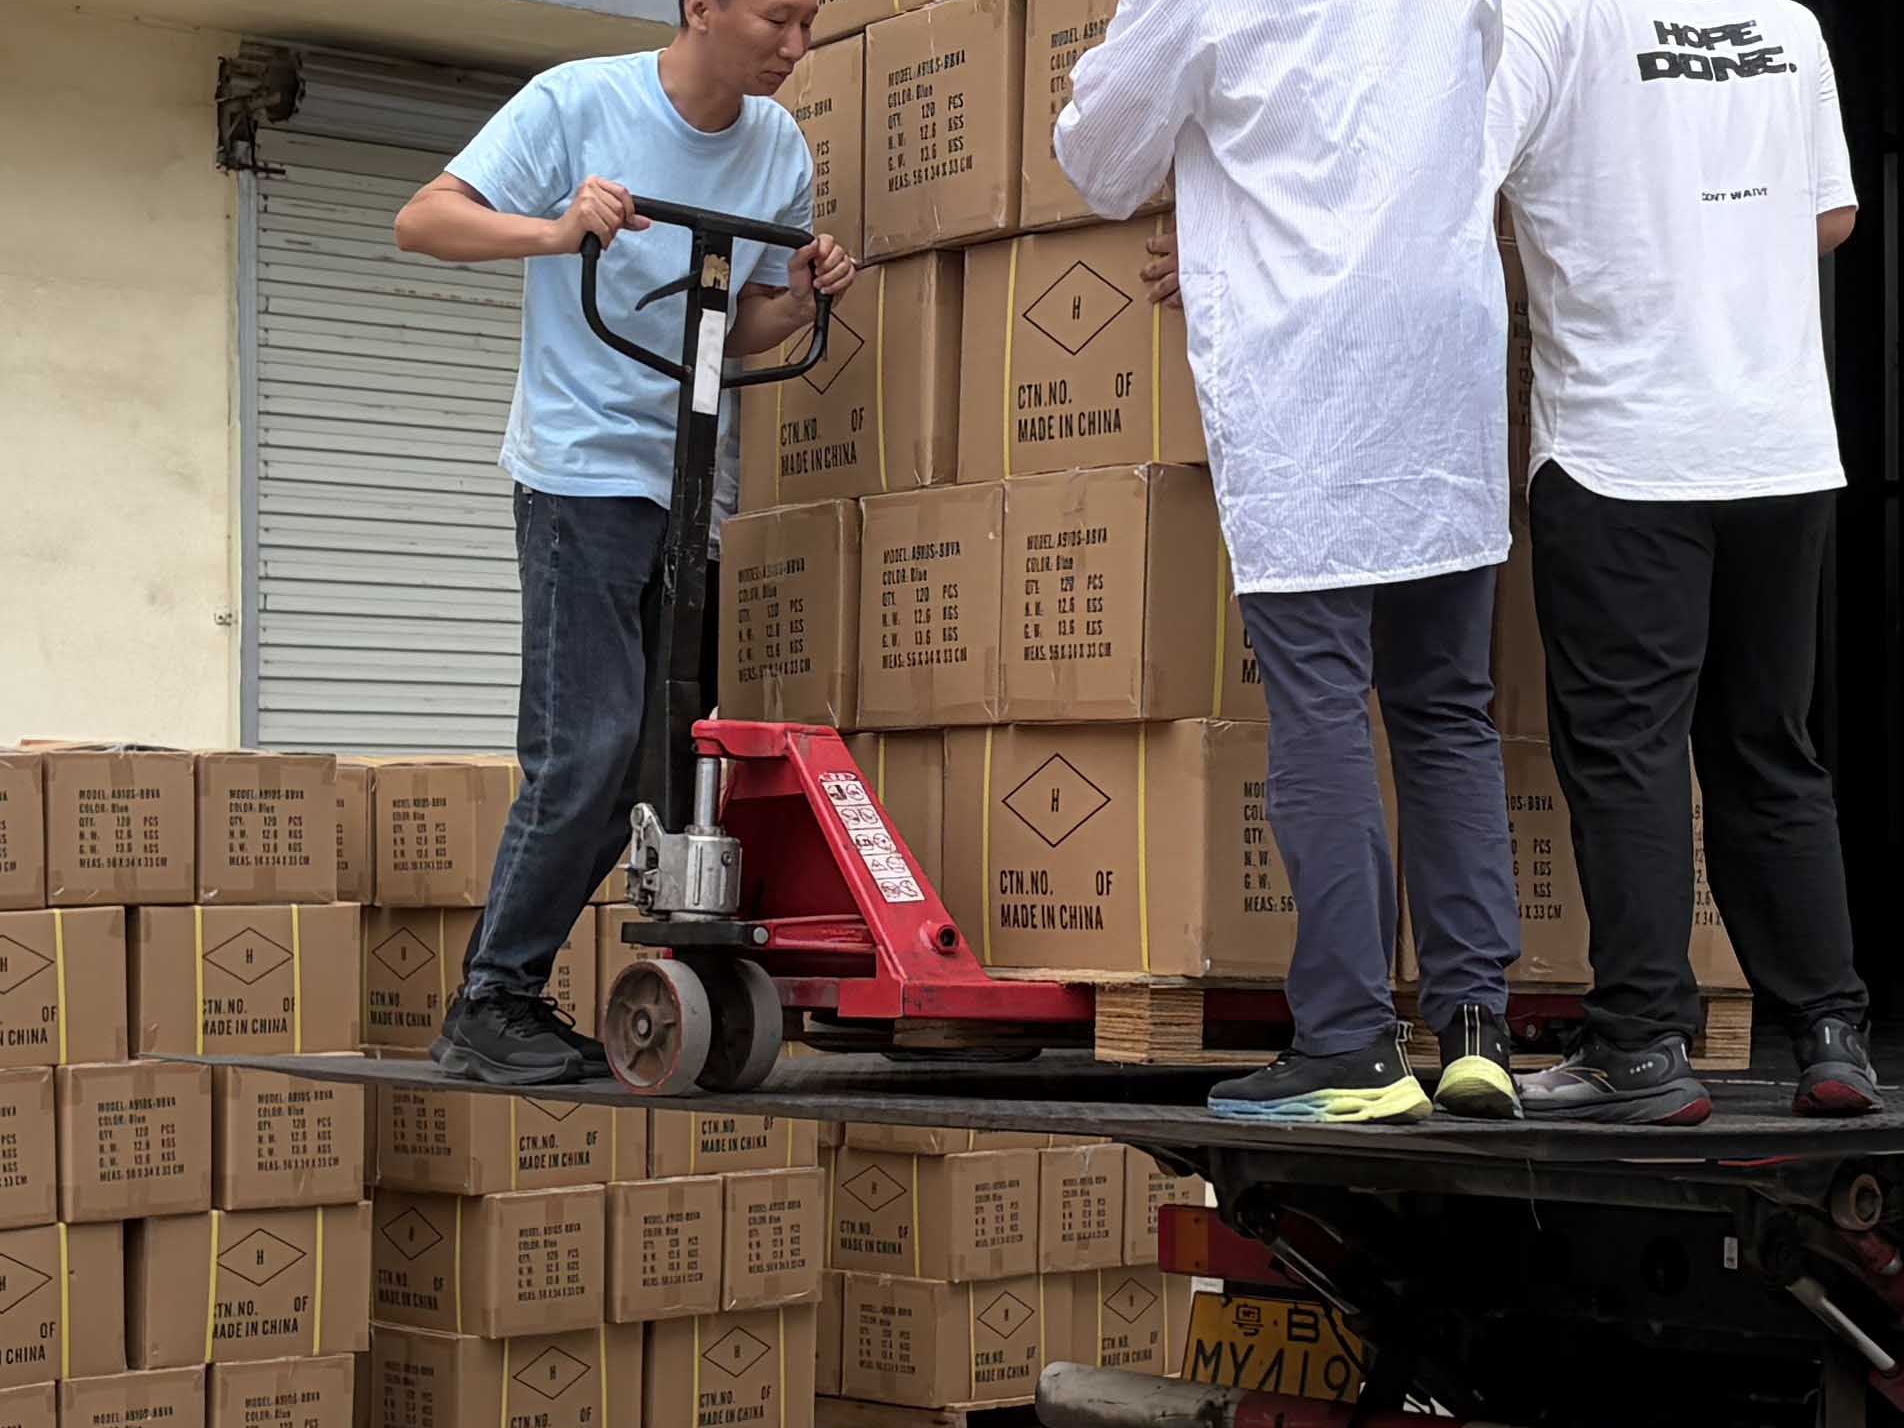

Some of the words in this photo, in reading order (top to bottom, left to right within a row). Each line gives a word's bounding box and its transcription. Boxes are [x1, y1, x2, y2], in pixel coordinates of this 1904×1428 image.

[1653, 19, 1763, 50] HOPE
[1072, 296, 1081, 320] H
[1018, 380, 1072, 409] CTN.NO.
[1116, 372, 1133, 398] OF
[1018, 415, 1054, 442] MADE
[1060, 414, 1073, 439] IN
[1078, 408, 1121, 436] CHINA
[1051, 788, 1059, 812] H
[1000, 870, 1053, 895] CTN.NO.
[1096, 871, 1113, 896] OF
[1001, 904, 1037, 929] MADE
[1047, 905, 1055, 929] IN
[1060, 905, 1103, 930] CHINA
[0, 957, 7, 972] H
[246, 948, 253, 964] H
[42, 1006, 57, 1022] OF
[236, 1020, 247, 1034] IN
[252, 1018, 287, 1034] CHINA
[8, 1028, 47, 1046] CHINA
